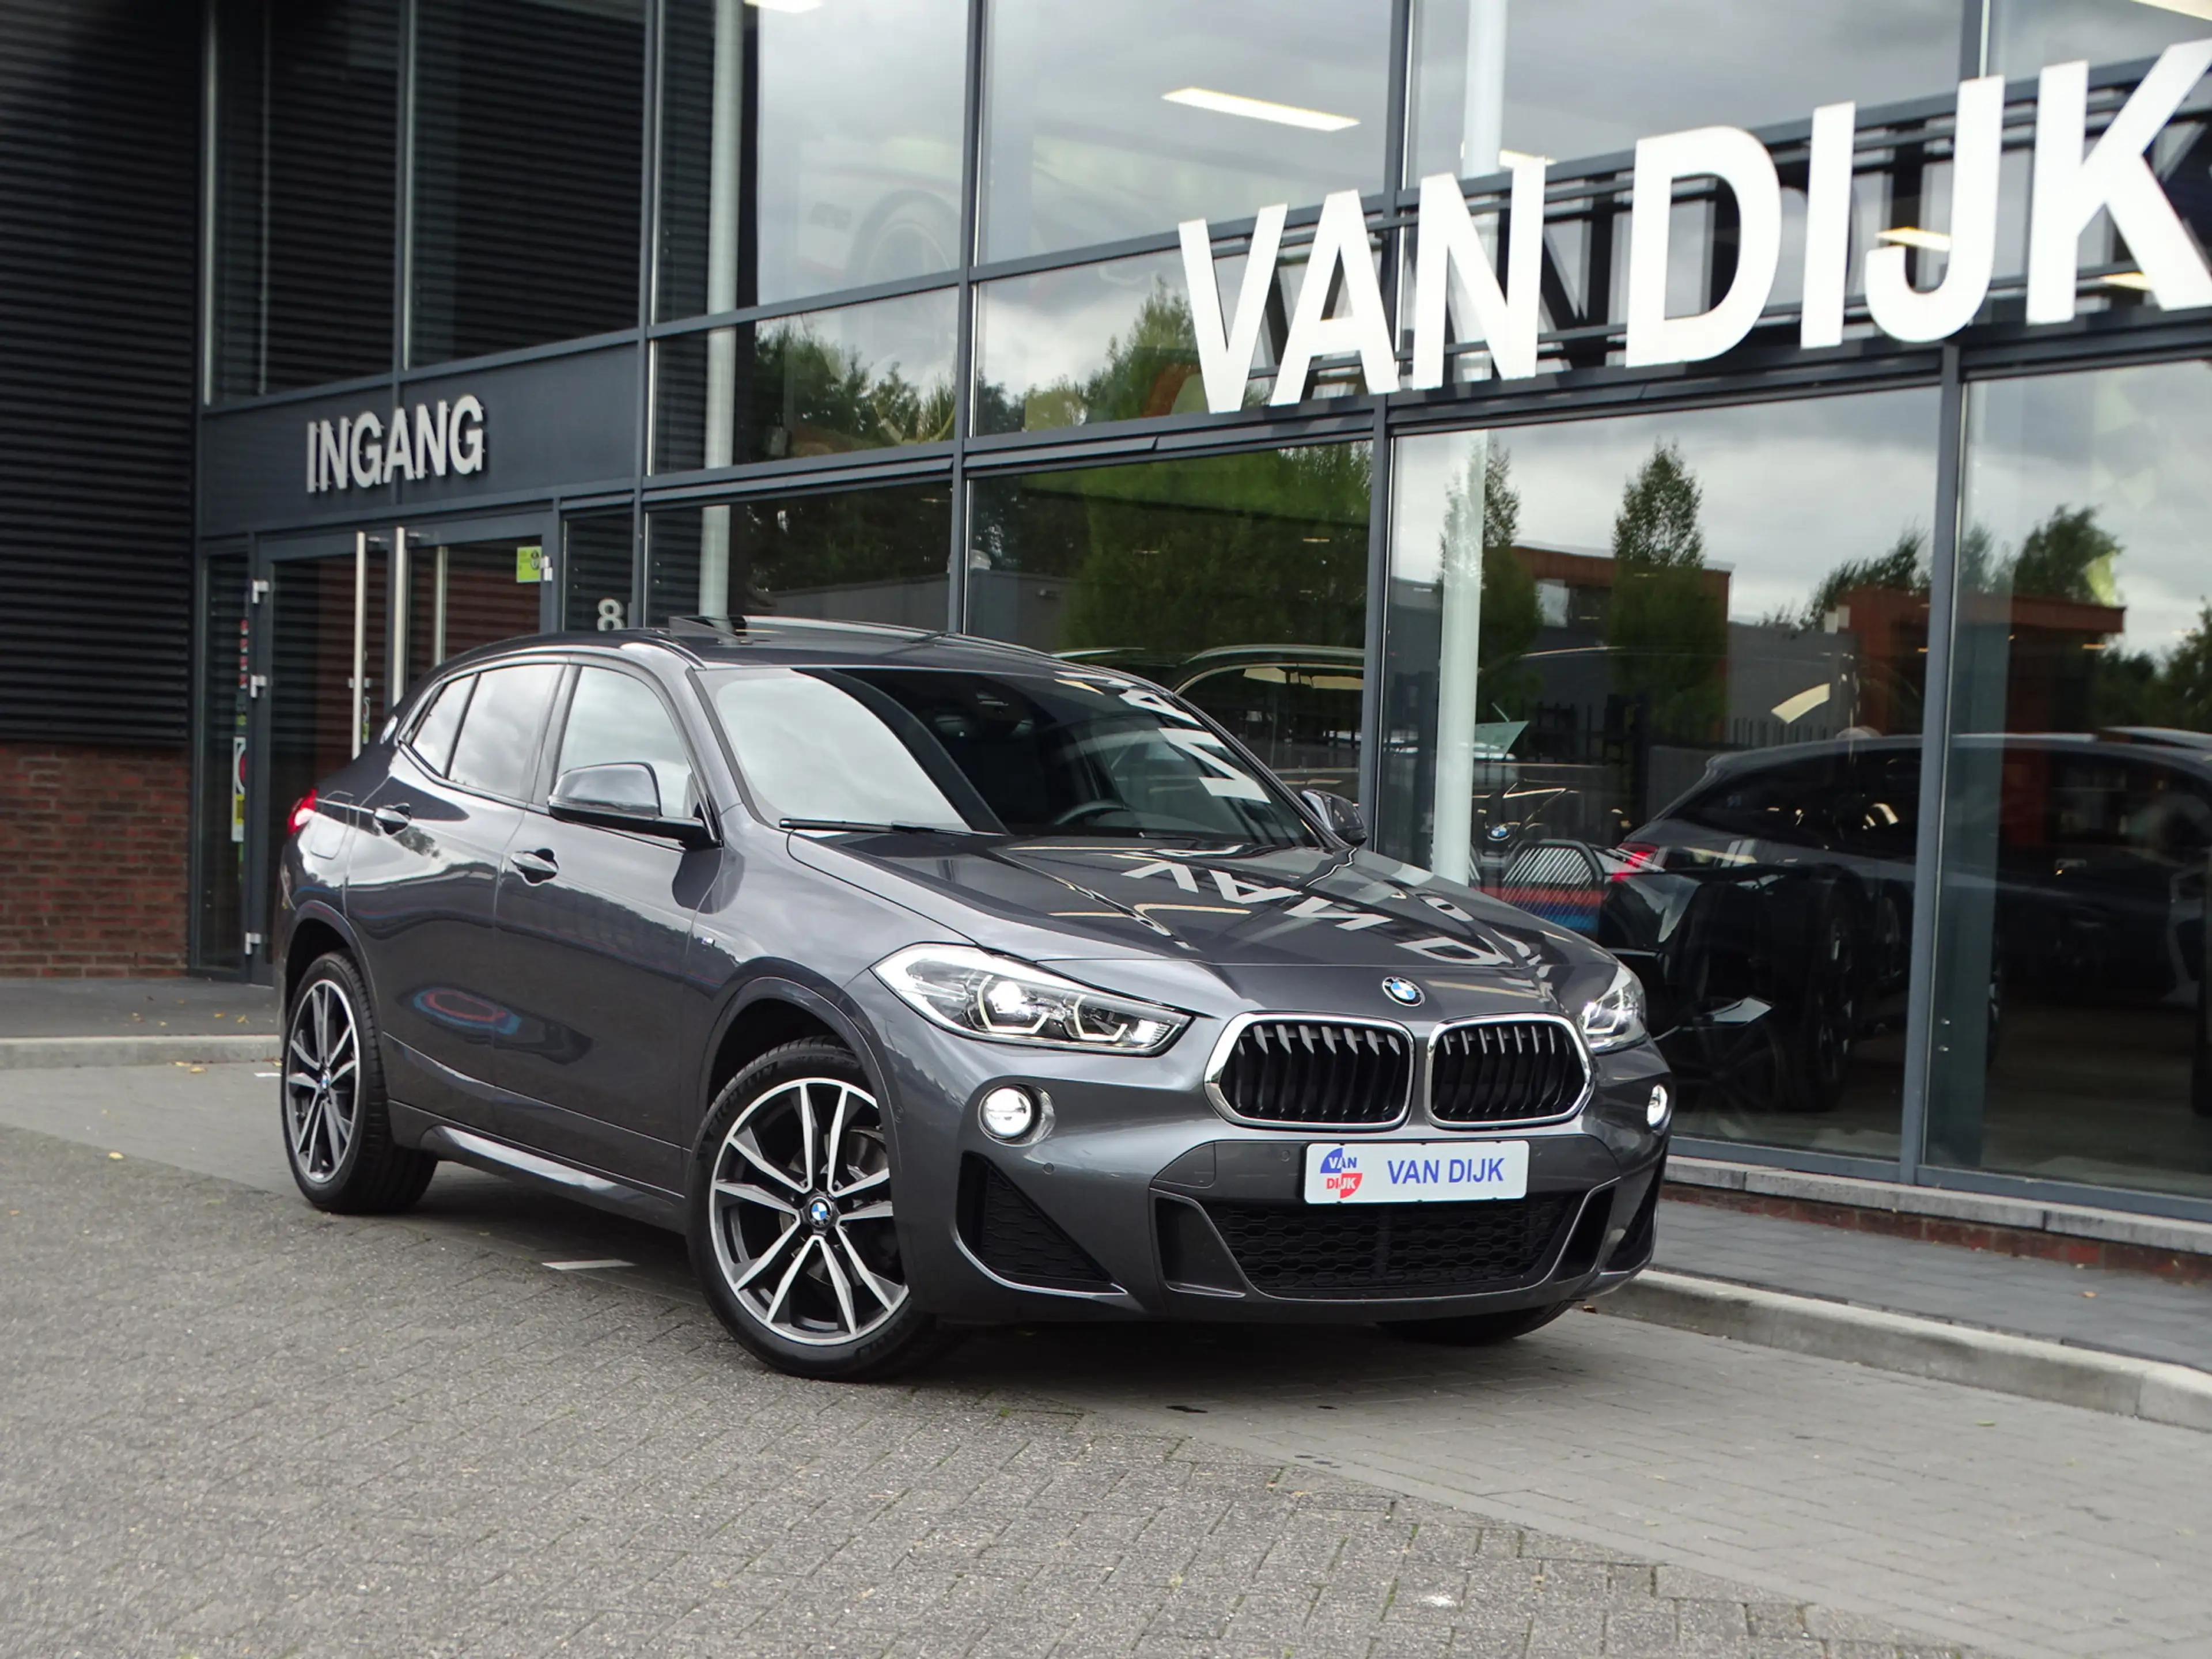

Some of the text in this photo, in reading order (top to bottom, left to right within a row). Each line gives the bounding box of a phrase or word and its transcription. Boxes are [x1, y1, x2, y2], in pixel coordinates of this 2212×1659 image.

[1178, 38, 2212, 414] VAN DIJK
[306, 394, 484, 493] INGANG
[597, 598, 623, 631] 8
[1328, 1157, 1357, 1169] VAN
[1387, 1157, 1505, 1184] VAN DIJK
[1326, 1177, 1357, 1190] DIJK
